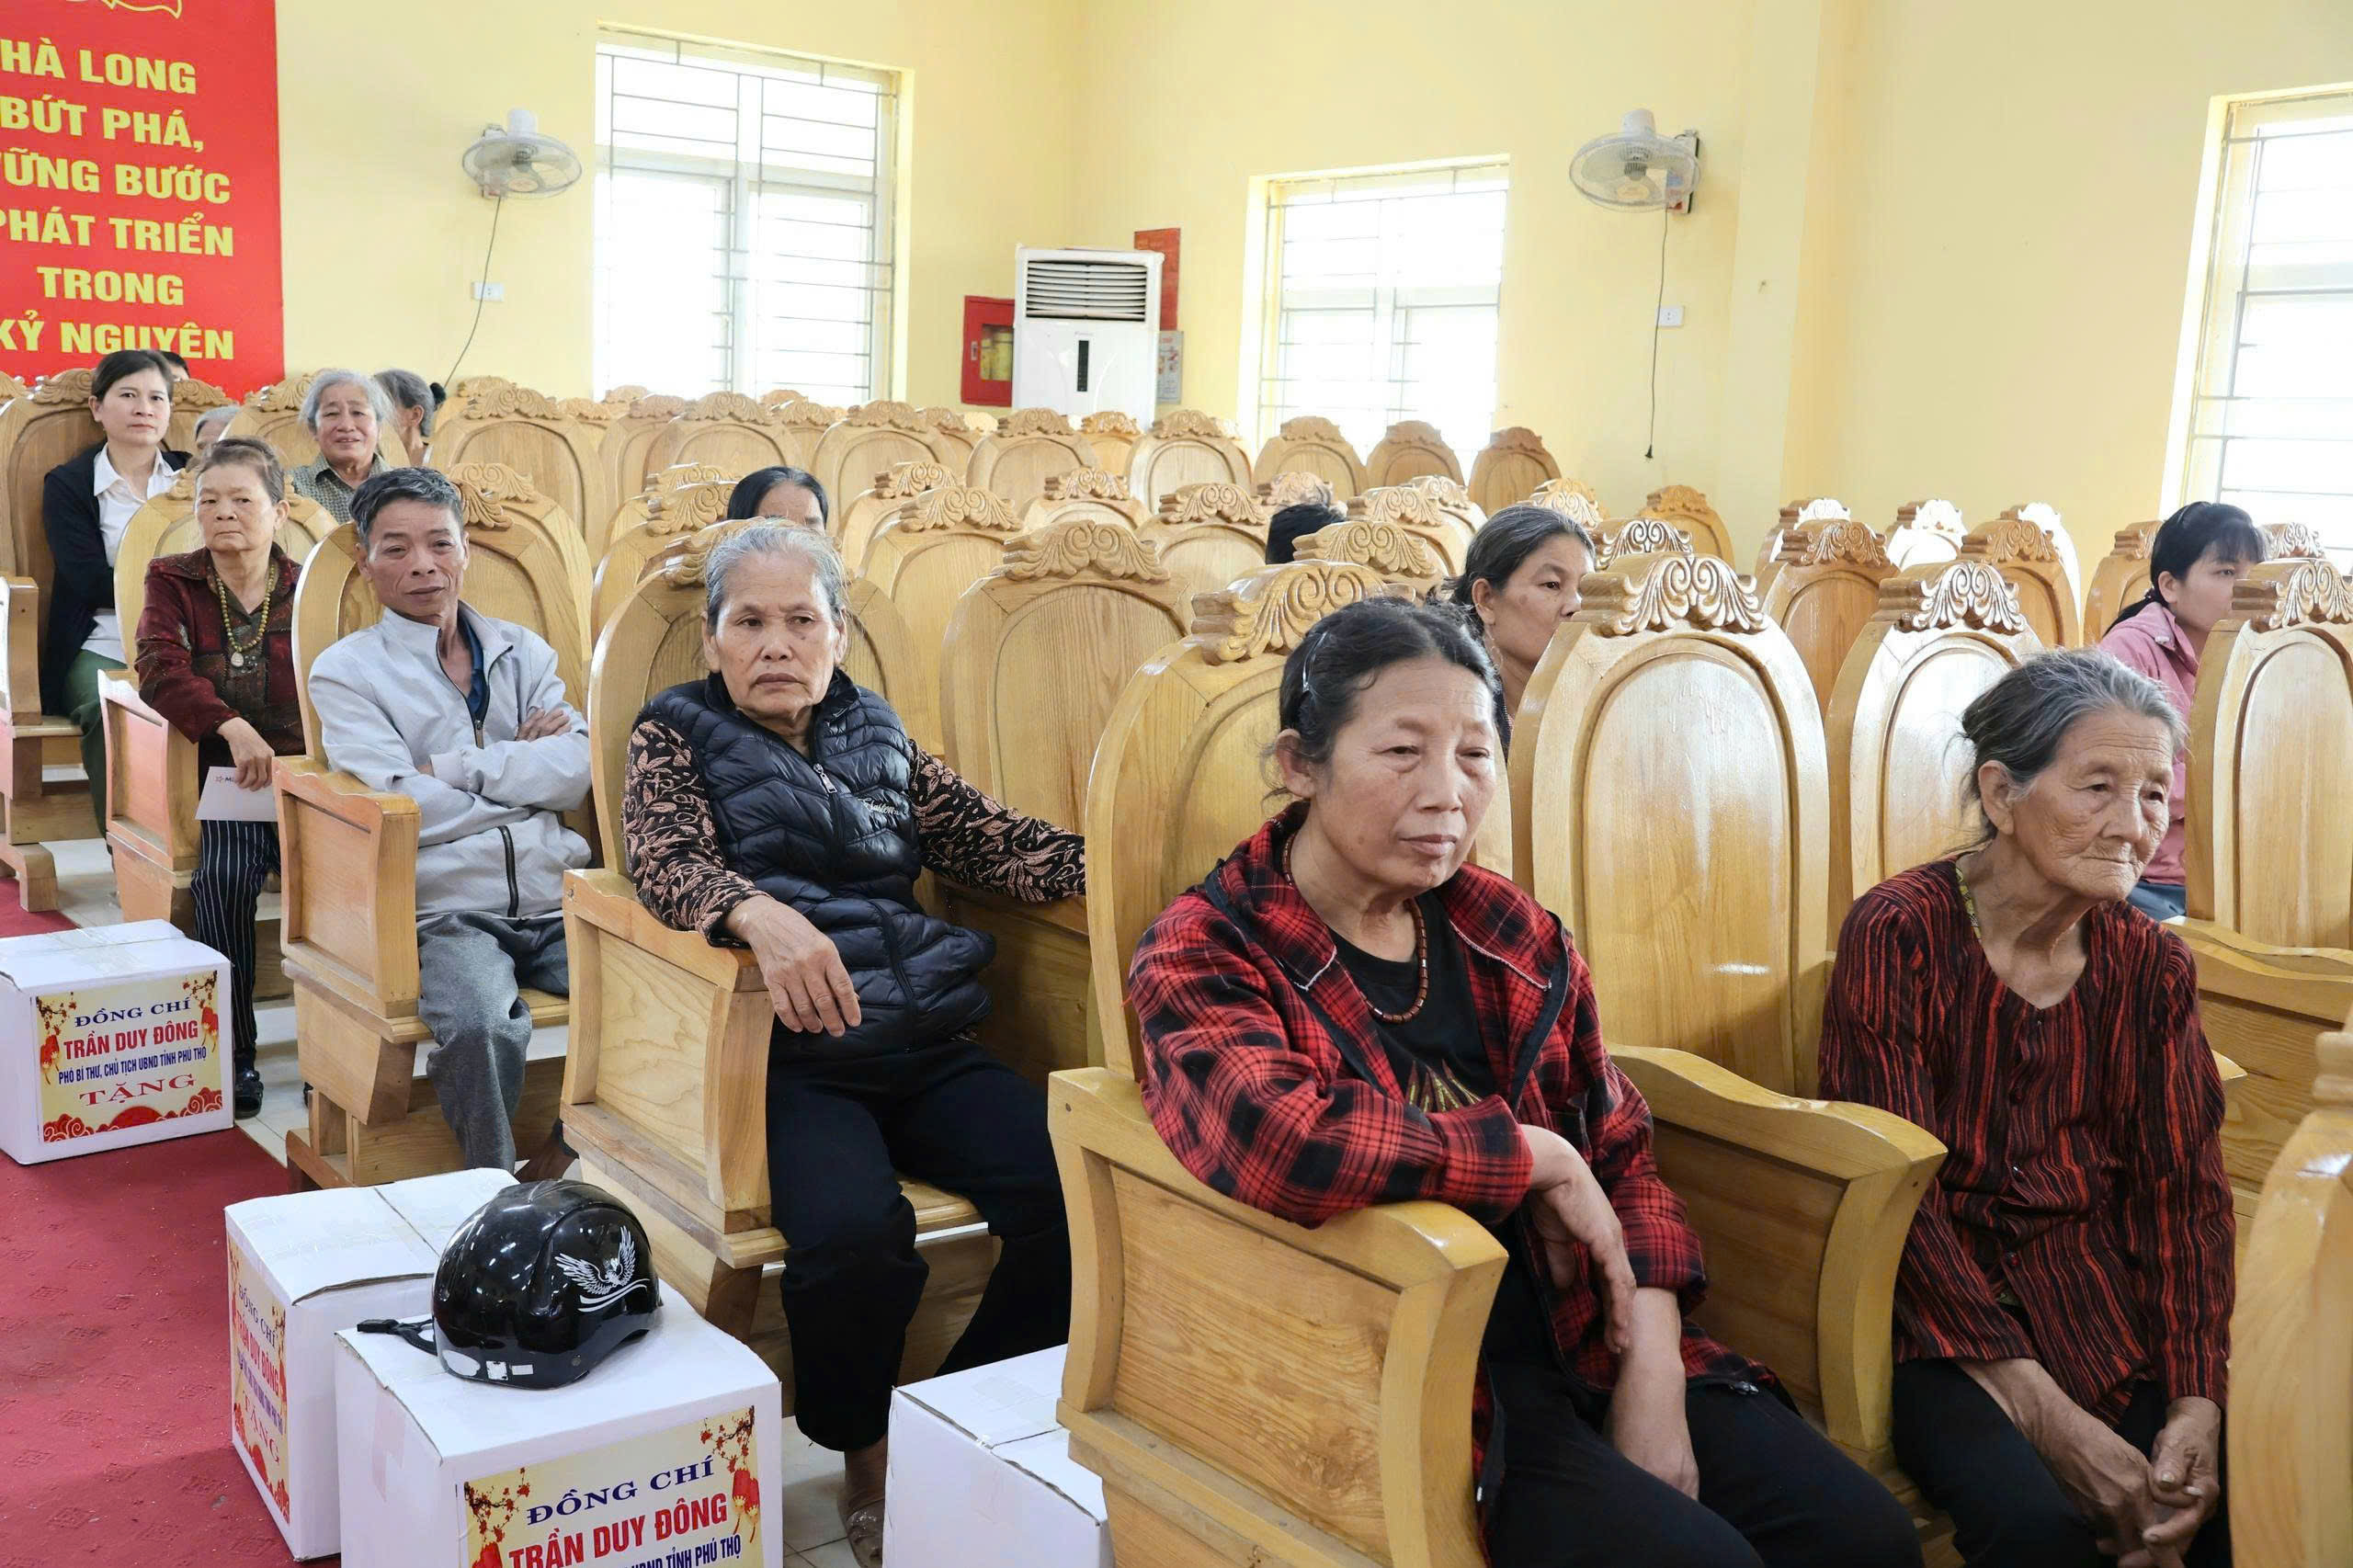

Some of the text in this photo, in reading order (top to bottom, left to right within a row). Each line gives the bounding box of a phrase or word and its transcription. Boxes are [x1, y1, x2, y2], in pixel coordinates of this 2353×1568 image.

[0, 37, 197, 95] HÀ LONG
[0, 95, 205, 153] BỨT PHÁ,
[0, 147, 231, 204] ỮNG BƯỚC
[108, 212, 233, 256] TRIỂN
[37, 266, 184, 306] TRONG
[61, 322, 234, 360] NGUYÊN
[74, 996, 191, 1028] ĐỒNG CHÍ
[63, 1020, 199, 1060] TRẦN DUY ĐÔNG
[58, 1067, 74, 1085] PHÓ
[76, 1065, 84, 1082] BÍ
[105, 1058, 119, 1076] CHỦ
[120, 1060, 137, 1076] TỊCH
[139, 1056, 159, 1071] UBND
[160, 1049, 176, 1066] TỈNH
[194, 1046, 207, 1062] THỌ
[79, 1074, 196, 1106] TẶNG
[527, 1455, 714, 1526] ĐỒNG CHÍ
[508, 1492, 728, 1568] TRẦN DUY ĐÔNG
[695, 1537, 718, 1567] PHÚ
[720, 1534, 742, 1560] THỌ
